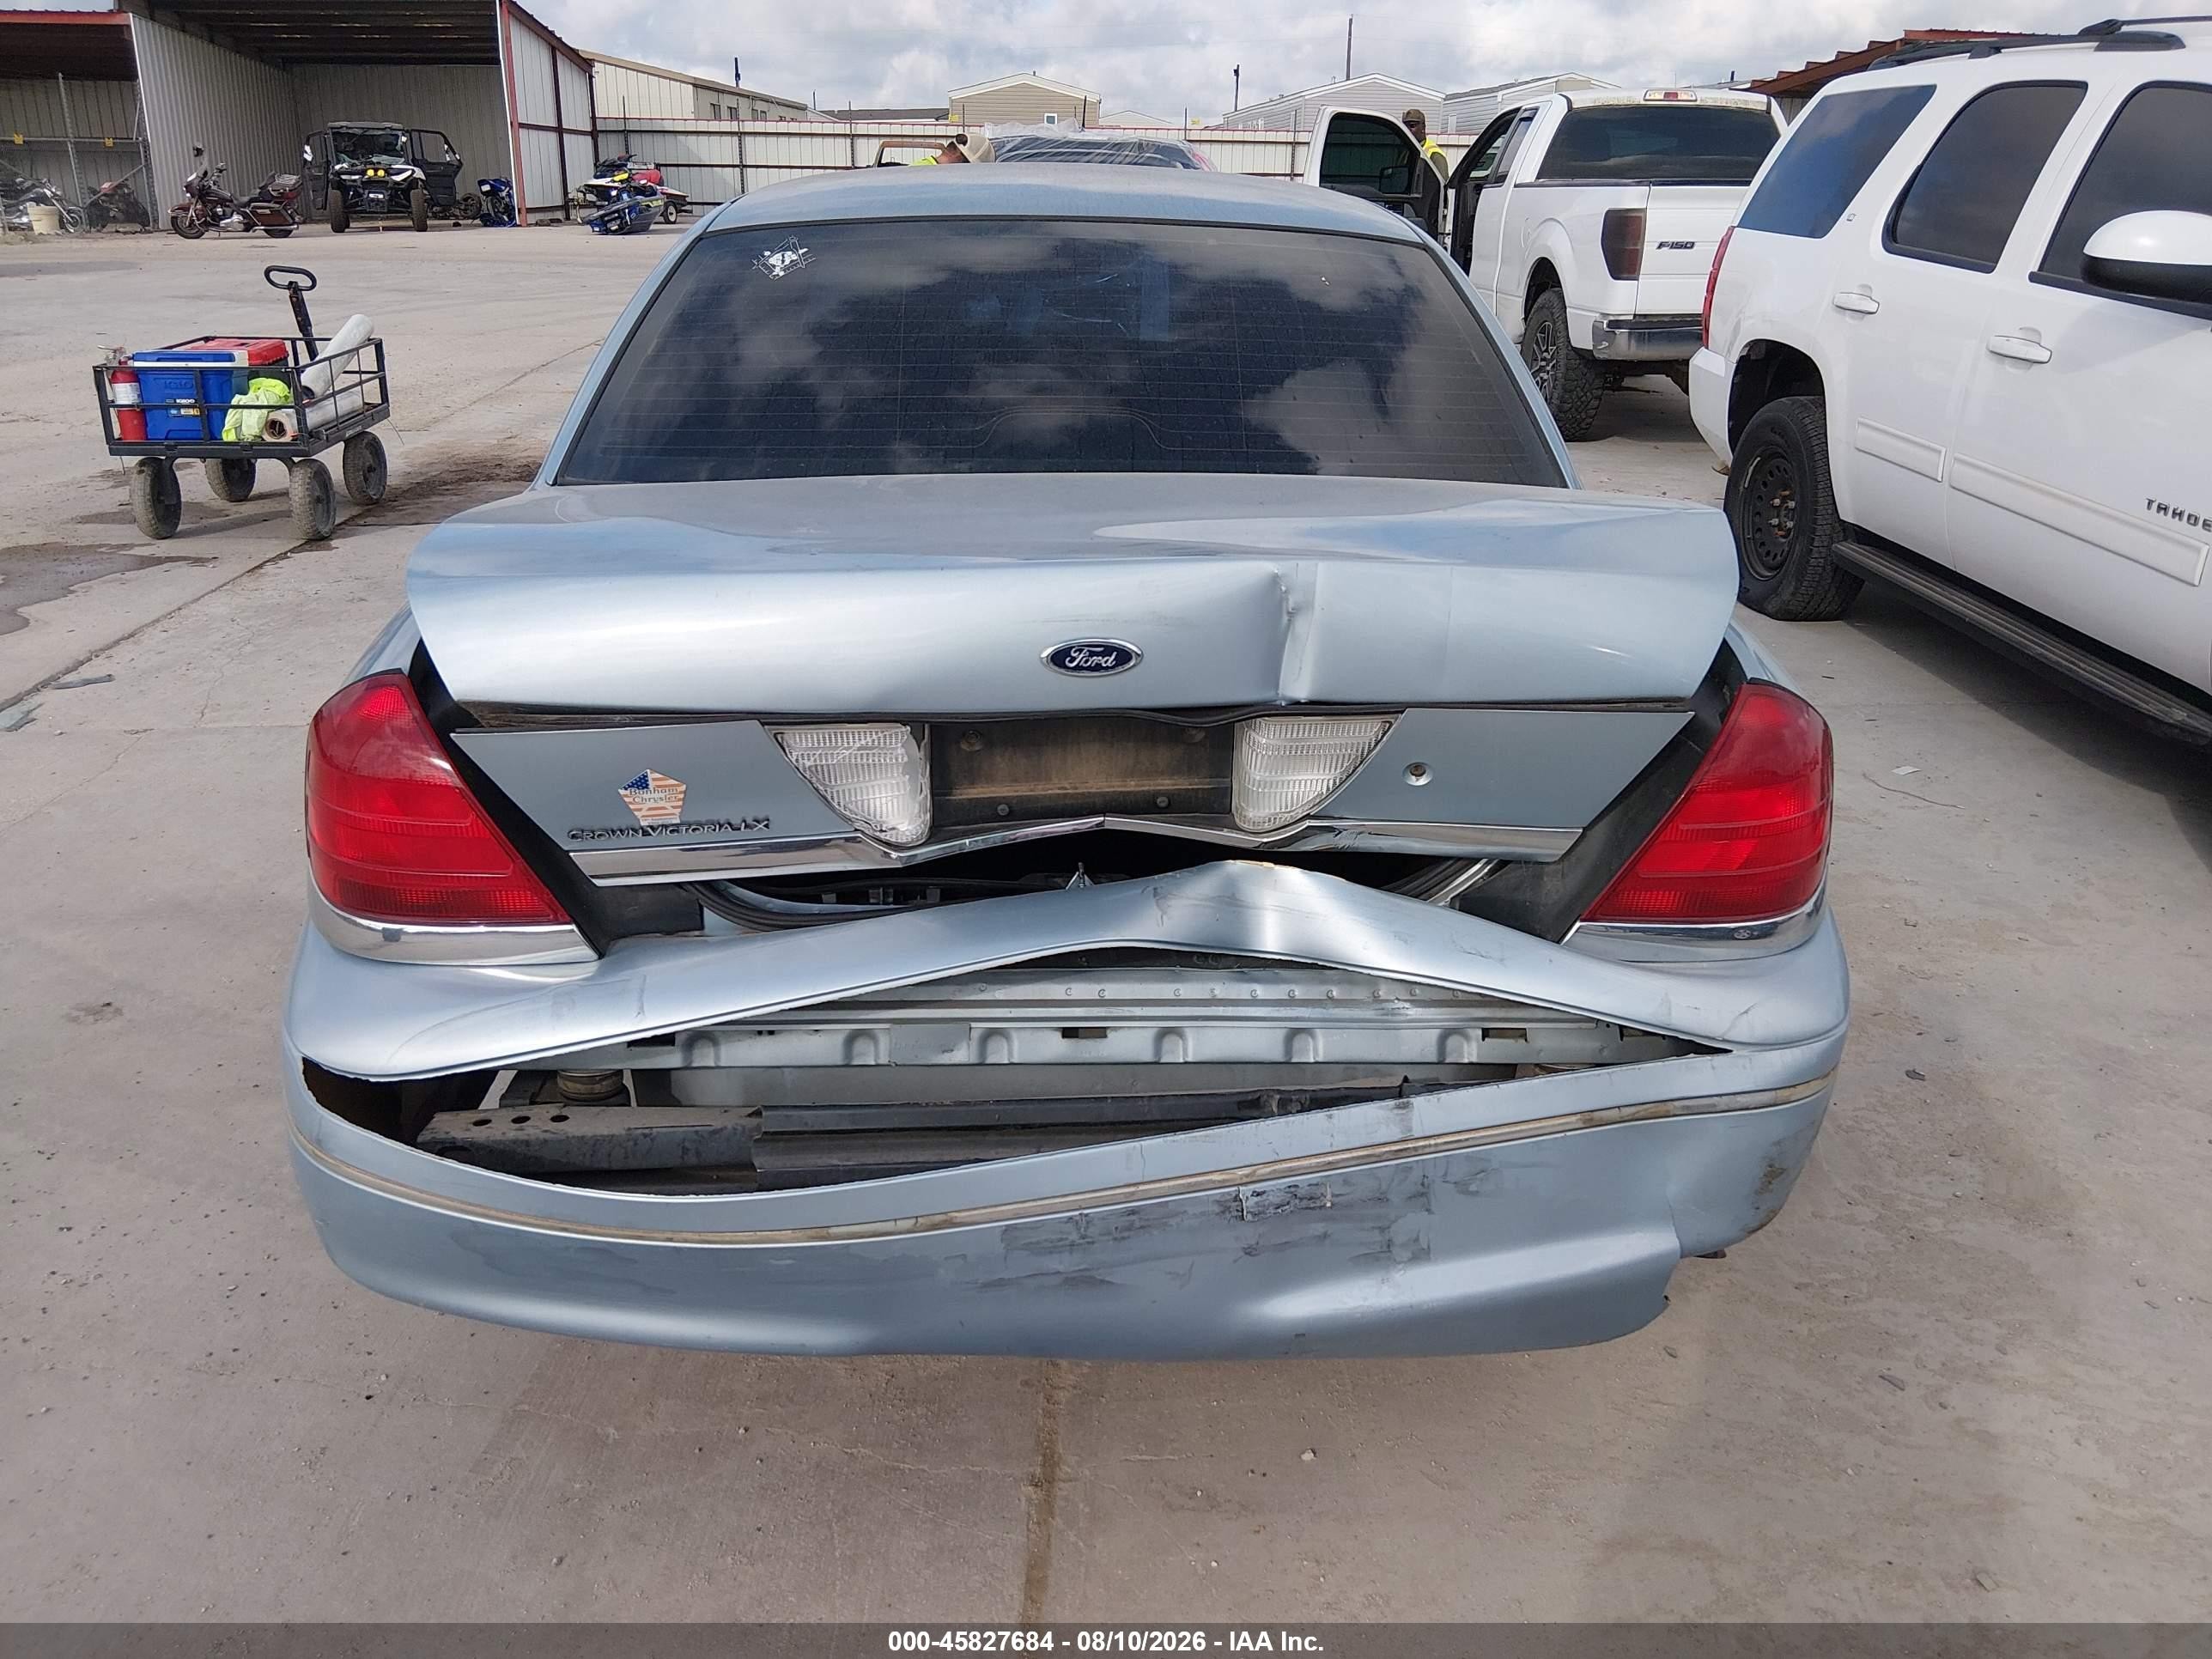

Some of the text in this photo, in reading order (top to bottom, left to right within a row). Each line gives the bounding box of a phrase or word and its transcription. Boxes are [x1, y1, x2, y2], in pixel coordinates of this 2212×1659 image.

[2146, 497, 2212, 532] TAHOE
[1065, 646, 1118, 668] Ford
[629, 787, 678, 796] Bonham
[633, 795, 678, 805] Chrysler
[739, 819, 769, 832] LX
